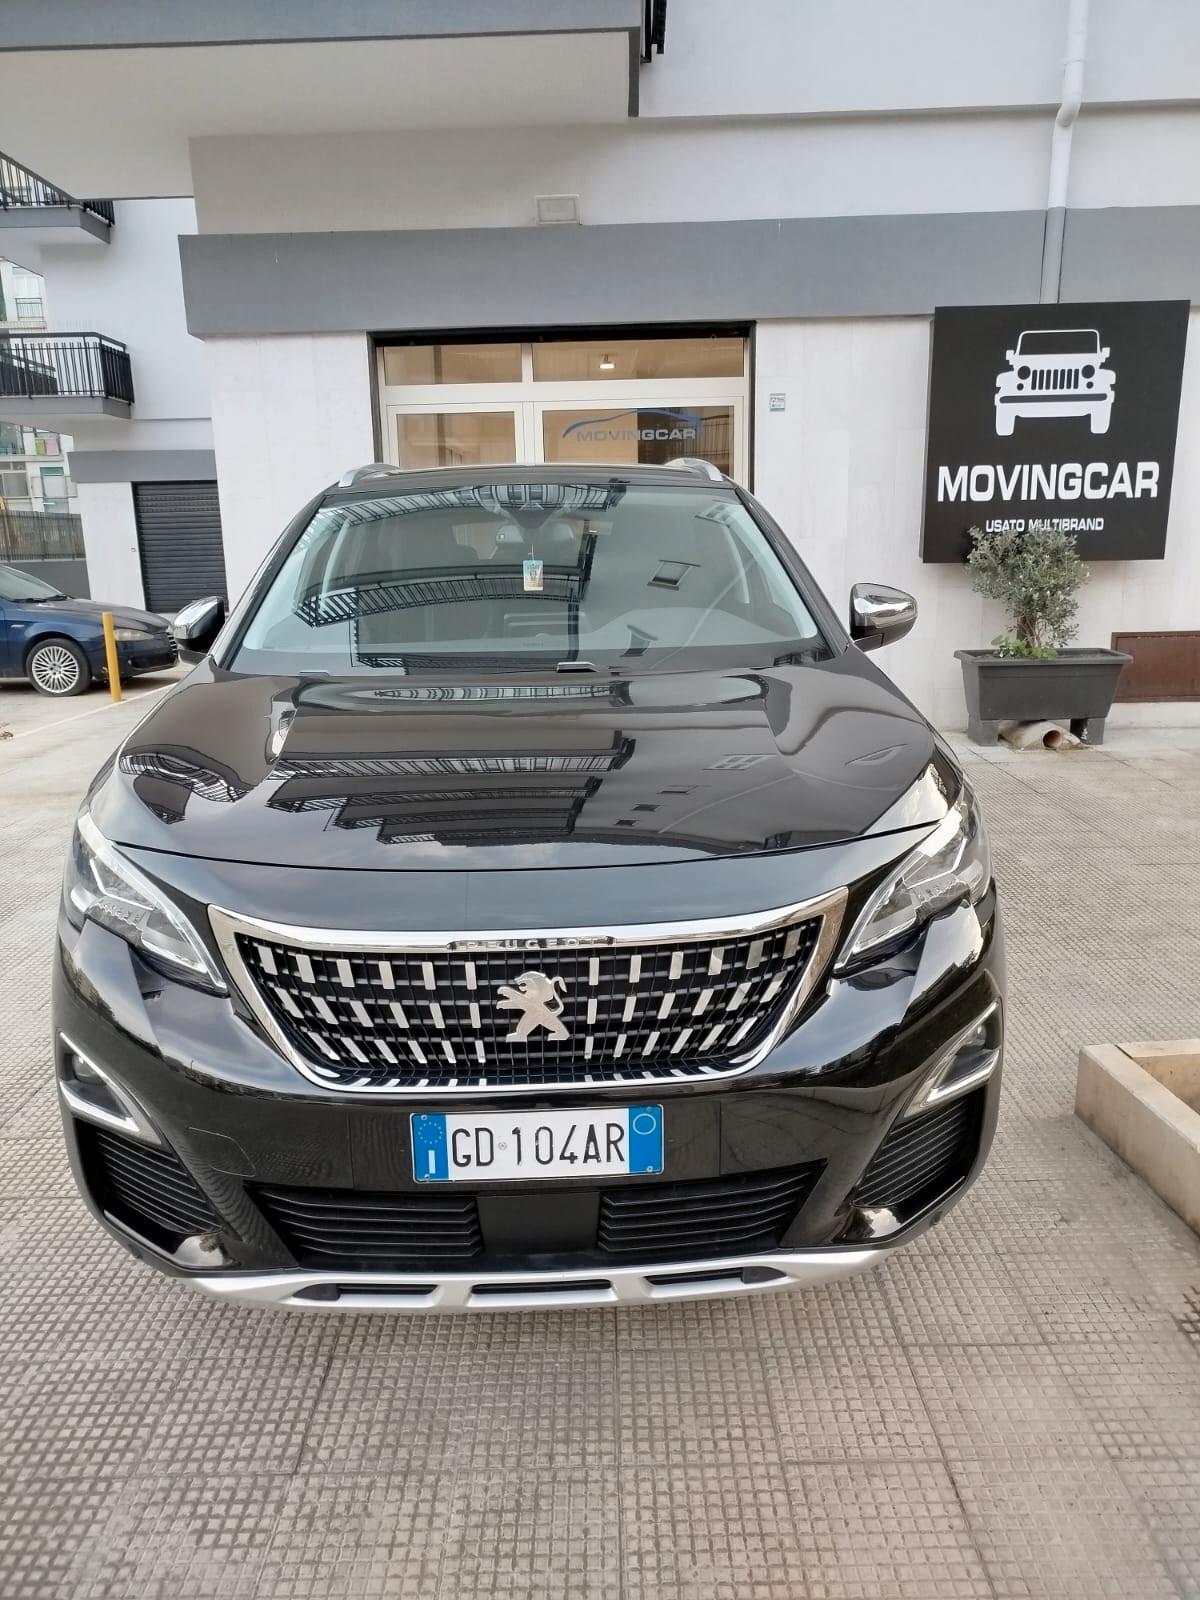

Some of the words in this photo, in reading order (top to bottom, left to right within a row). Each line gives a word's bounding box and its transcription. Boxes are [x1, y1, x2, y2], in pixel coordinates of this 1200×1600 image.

[576, 428, 697, 442] MOVINGCAR
[937, 461, 1160, 502] MOVINGCAR
[986, 519, 1026, 532] USATO
[1028, 517, 1105, 531] MULTIBRAND
